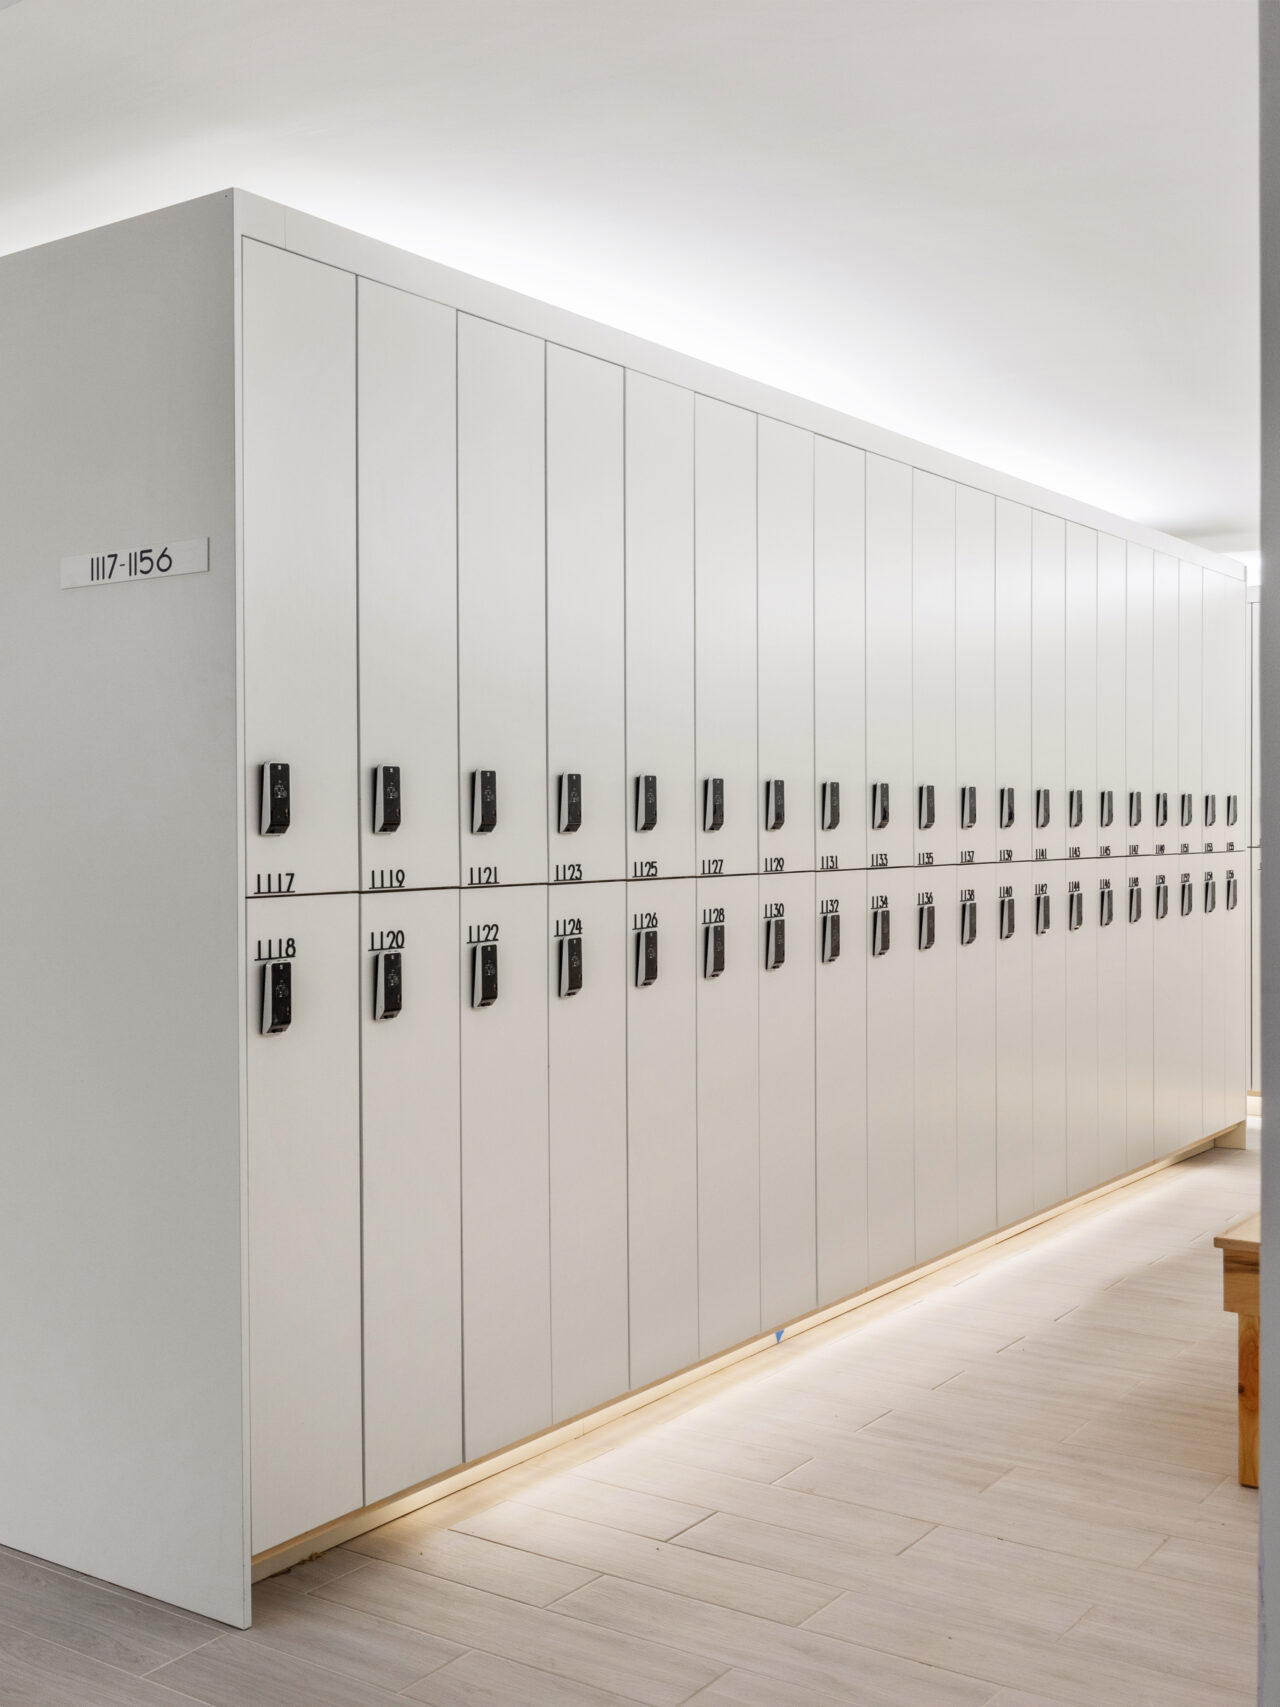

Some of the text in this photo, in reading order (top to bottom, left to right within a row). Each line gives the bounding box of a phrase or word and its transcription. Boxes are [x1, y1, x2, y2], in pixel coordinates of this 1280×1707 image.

[90, 547, 172, 581] 1117-1156
[918, 853, 934, 865] 1135
[961, 850, 974, 863] 1137
[1000, 850, 1012, 861] 1139
[1036, 848, 1047, 860] 1141
[1069, 847, 1080, 857] 1143
[701, 860, 723, 874] 1127
[764, 858, 784, 872] 1129
[821, 856, 838, 869] 1131
[871, 854, 888, 866] 1133
[469, 866, 499, 884] 1121
[554, 864, 582, 880] 1123
[633, 861, 658, 877] 1125
[255, 873, 294, 893] 1117
[369, 870, 405, 888] 1119
[999, 886, 1012, 898] 1140
[1035, 884, 1047, 895] 1142
[1069, 881, 1080, 892] 1144
[871, 896, 888, 909] 1134
[917, 892, 933, 905] 1136
[960, 889, 974, 902] 1138
[764, 904, 784, 918] 1130
[820, 900, 839, 914] 1132
[632, 913, 658, 929] 1126
[702, 909, 724, 924] 1128
[467, 924, 498, 943] 1122
[554, 919, 582, 936] 1124
[369, 930, 404, 950] 1120
[254, 938, 296, 960] 1118
